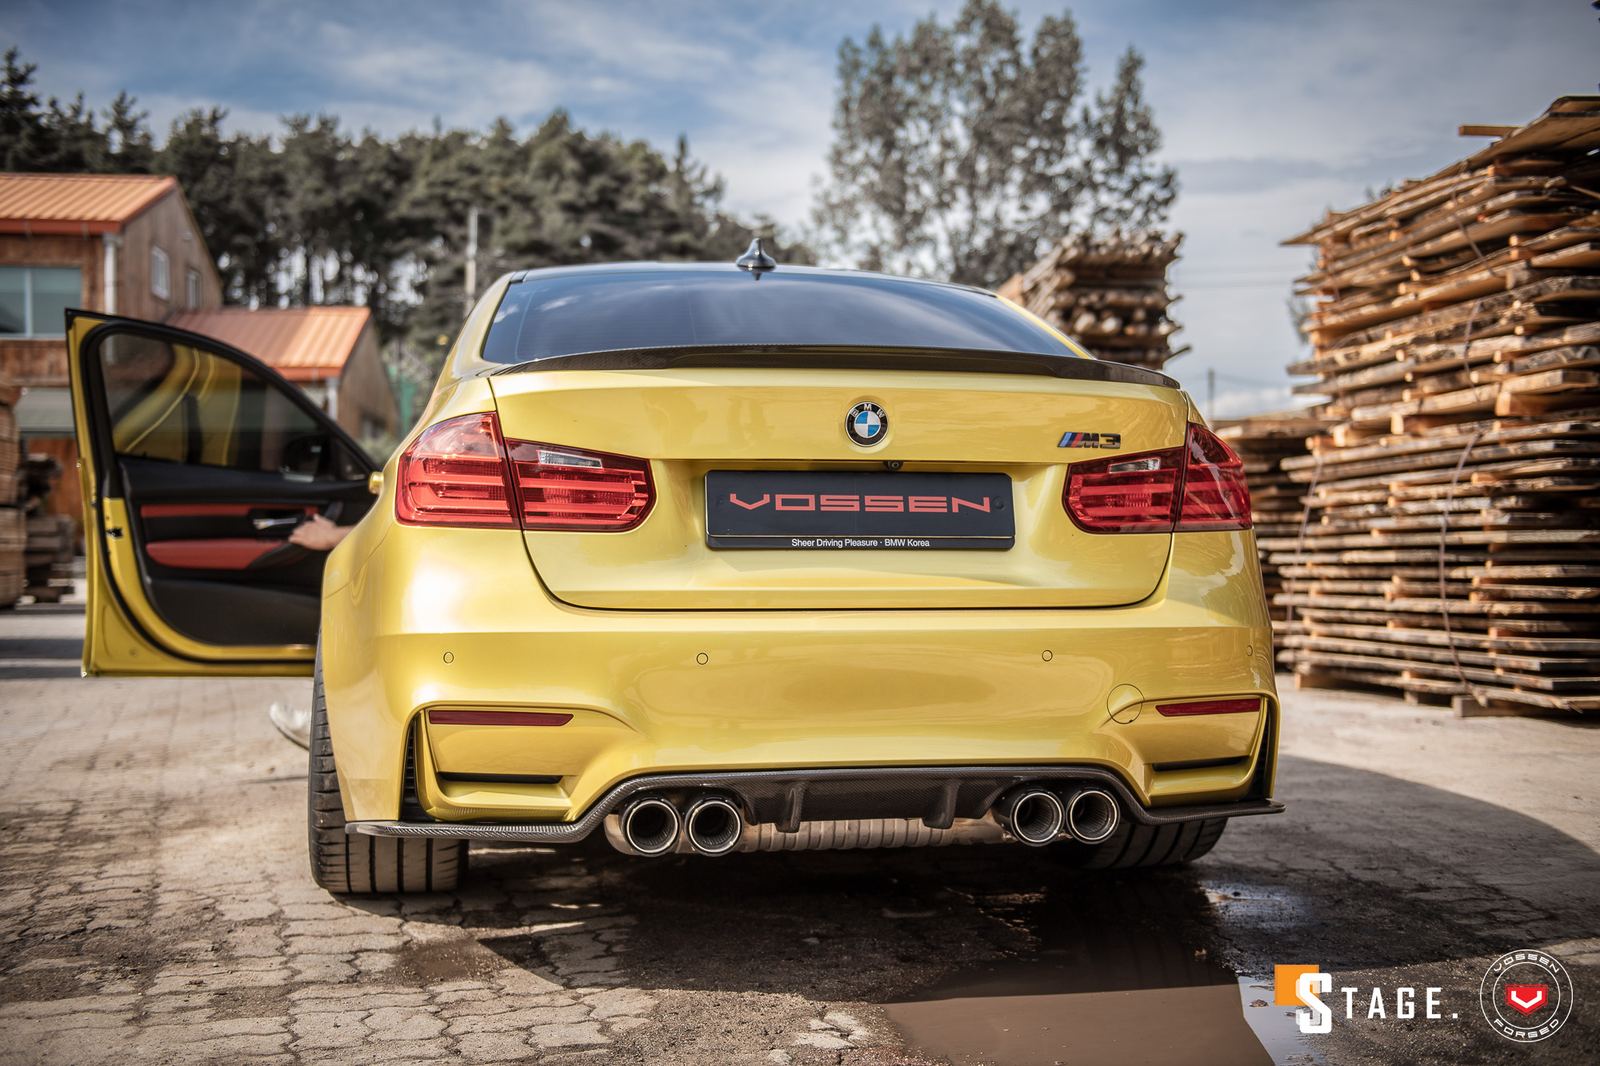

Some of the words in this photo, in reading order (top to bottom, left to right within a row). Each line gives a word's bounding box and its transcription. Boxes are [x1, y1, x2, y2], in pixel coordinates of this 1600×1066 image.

[850, 403, 885, 418] BMW
[1074, 432, 1121, 449] M3
[729, 493, 991, 513] VOSSEN
[791, 538, 815, 547] Sheer
[816, 538, 843, 548] Driving
[844, 538, 878, 547] Pleasure
[885, 538, 906, 547] BMW
[907, 538, 930, 547] Korea
